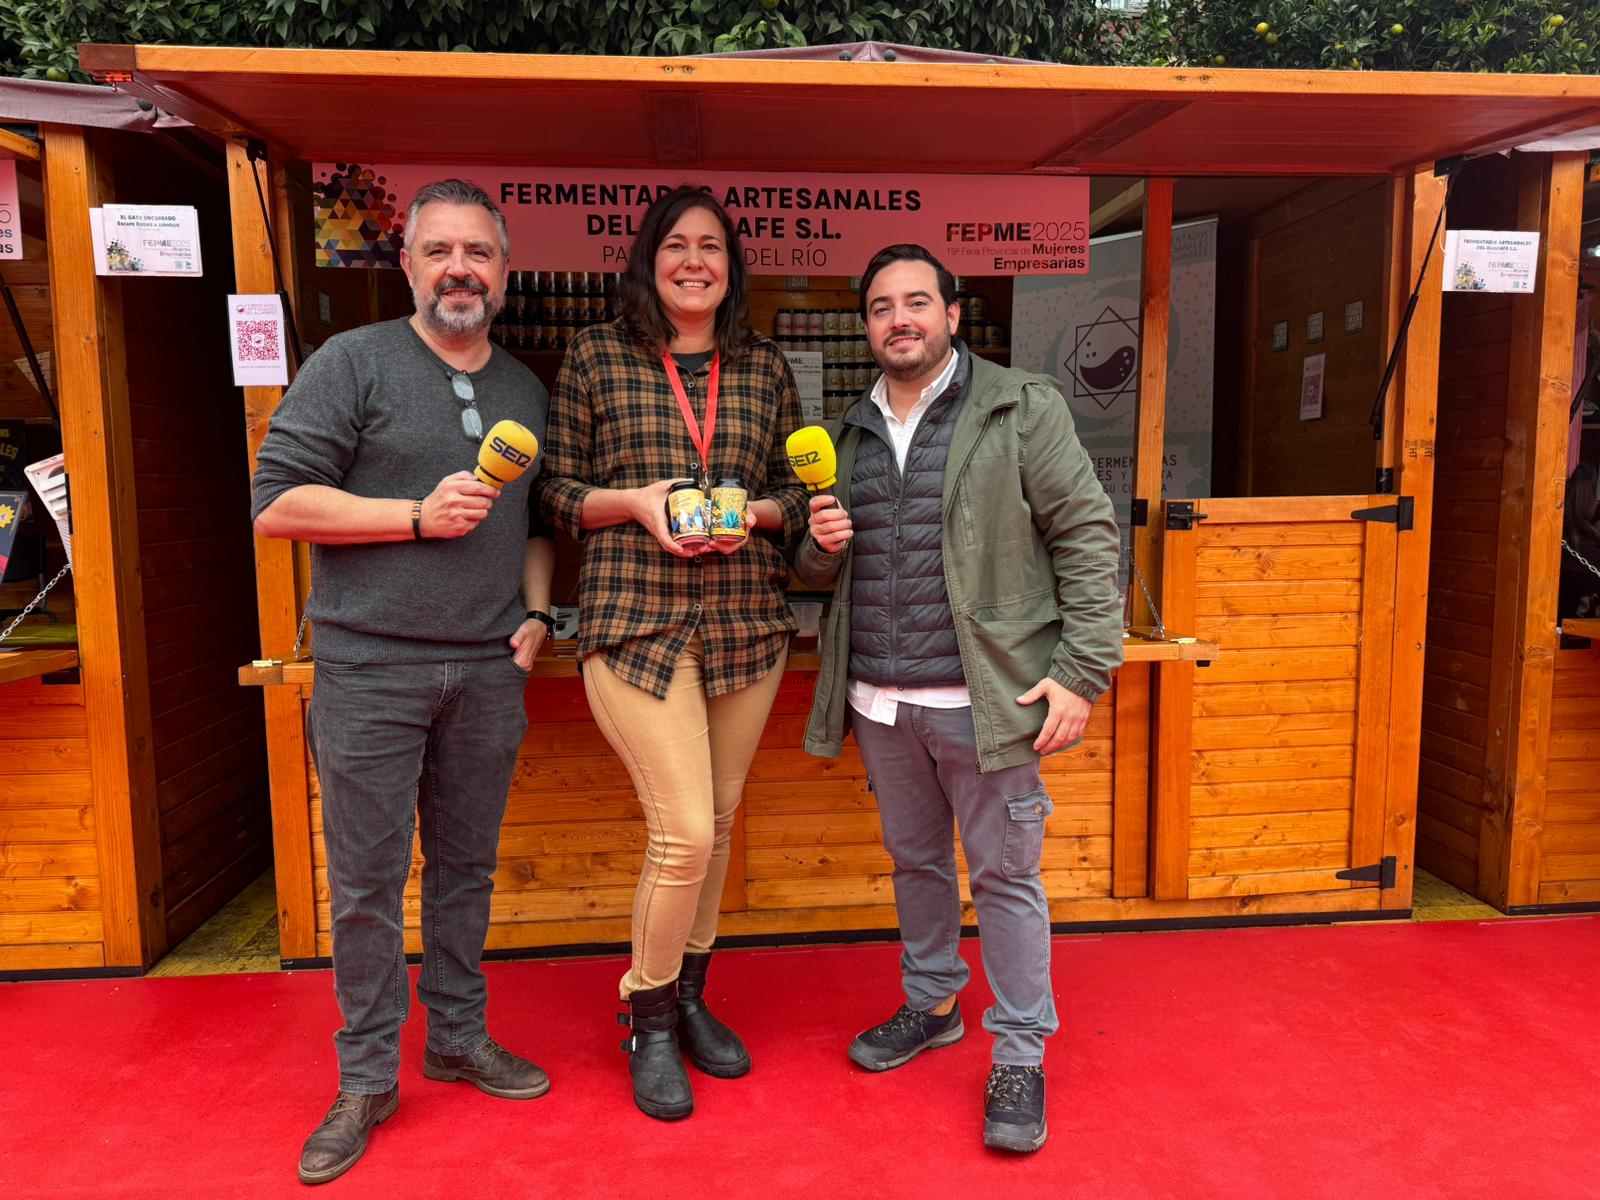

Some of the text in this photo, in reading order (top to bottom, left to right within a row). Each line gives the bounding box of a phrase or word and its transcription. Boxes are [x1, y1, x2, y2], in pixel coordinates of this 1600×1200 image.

[500, 182, 922, 211] FERMENTADS ARTESANALES
[586, 213, 638, 237] DEL
[794, 216, 842, 240] S.L.
[946, 221, 1086, 242] FEPME2025
[744, 247, 780, 267] DEL
[791, 242, 827, 267] RÍO
[982, 247, 1018, 256] Provincial
[1032, 243, 1085, 257] Mujeres
[994, 257, 1086, 272] Empresarias
[489, 436, 531, 468] SER
[788, 450, 821, 468] SER
